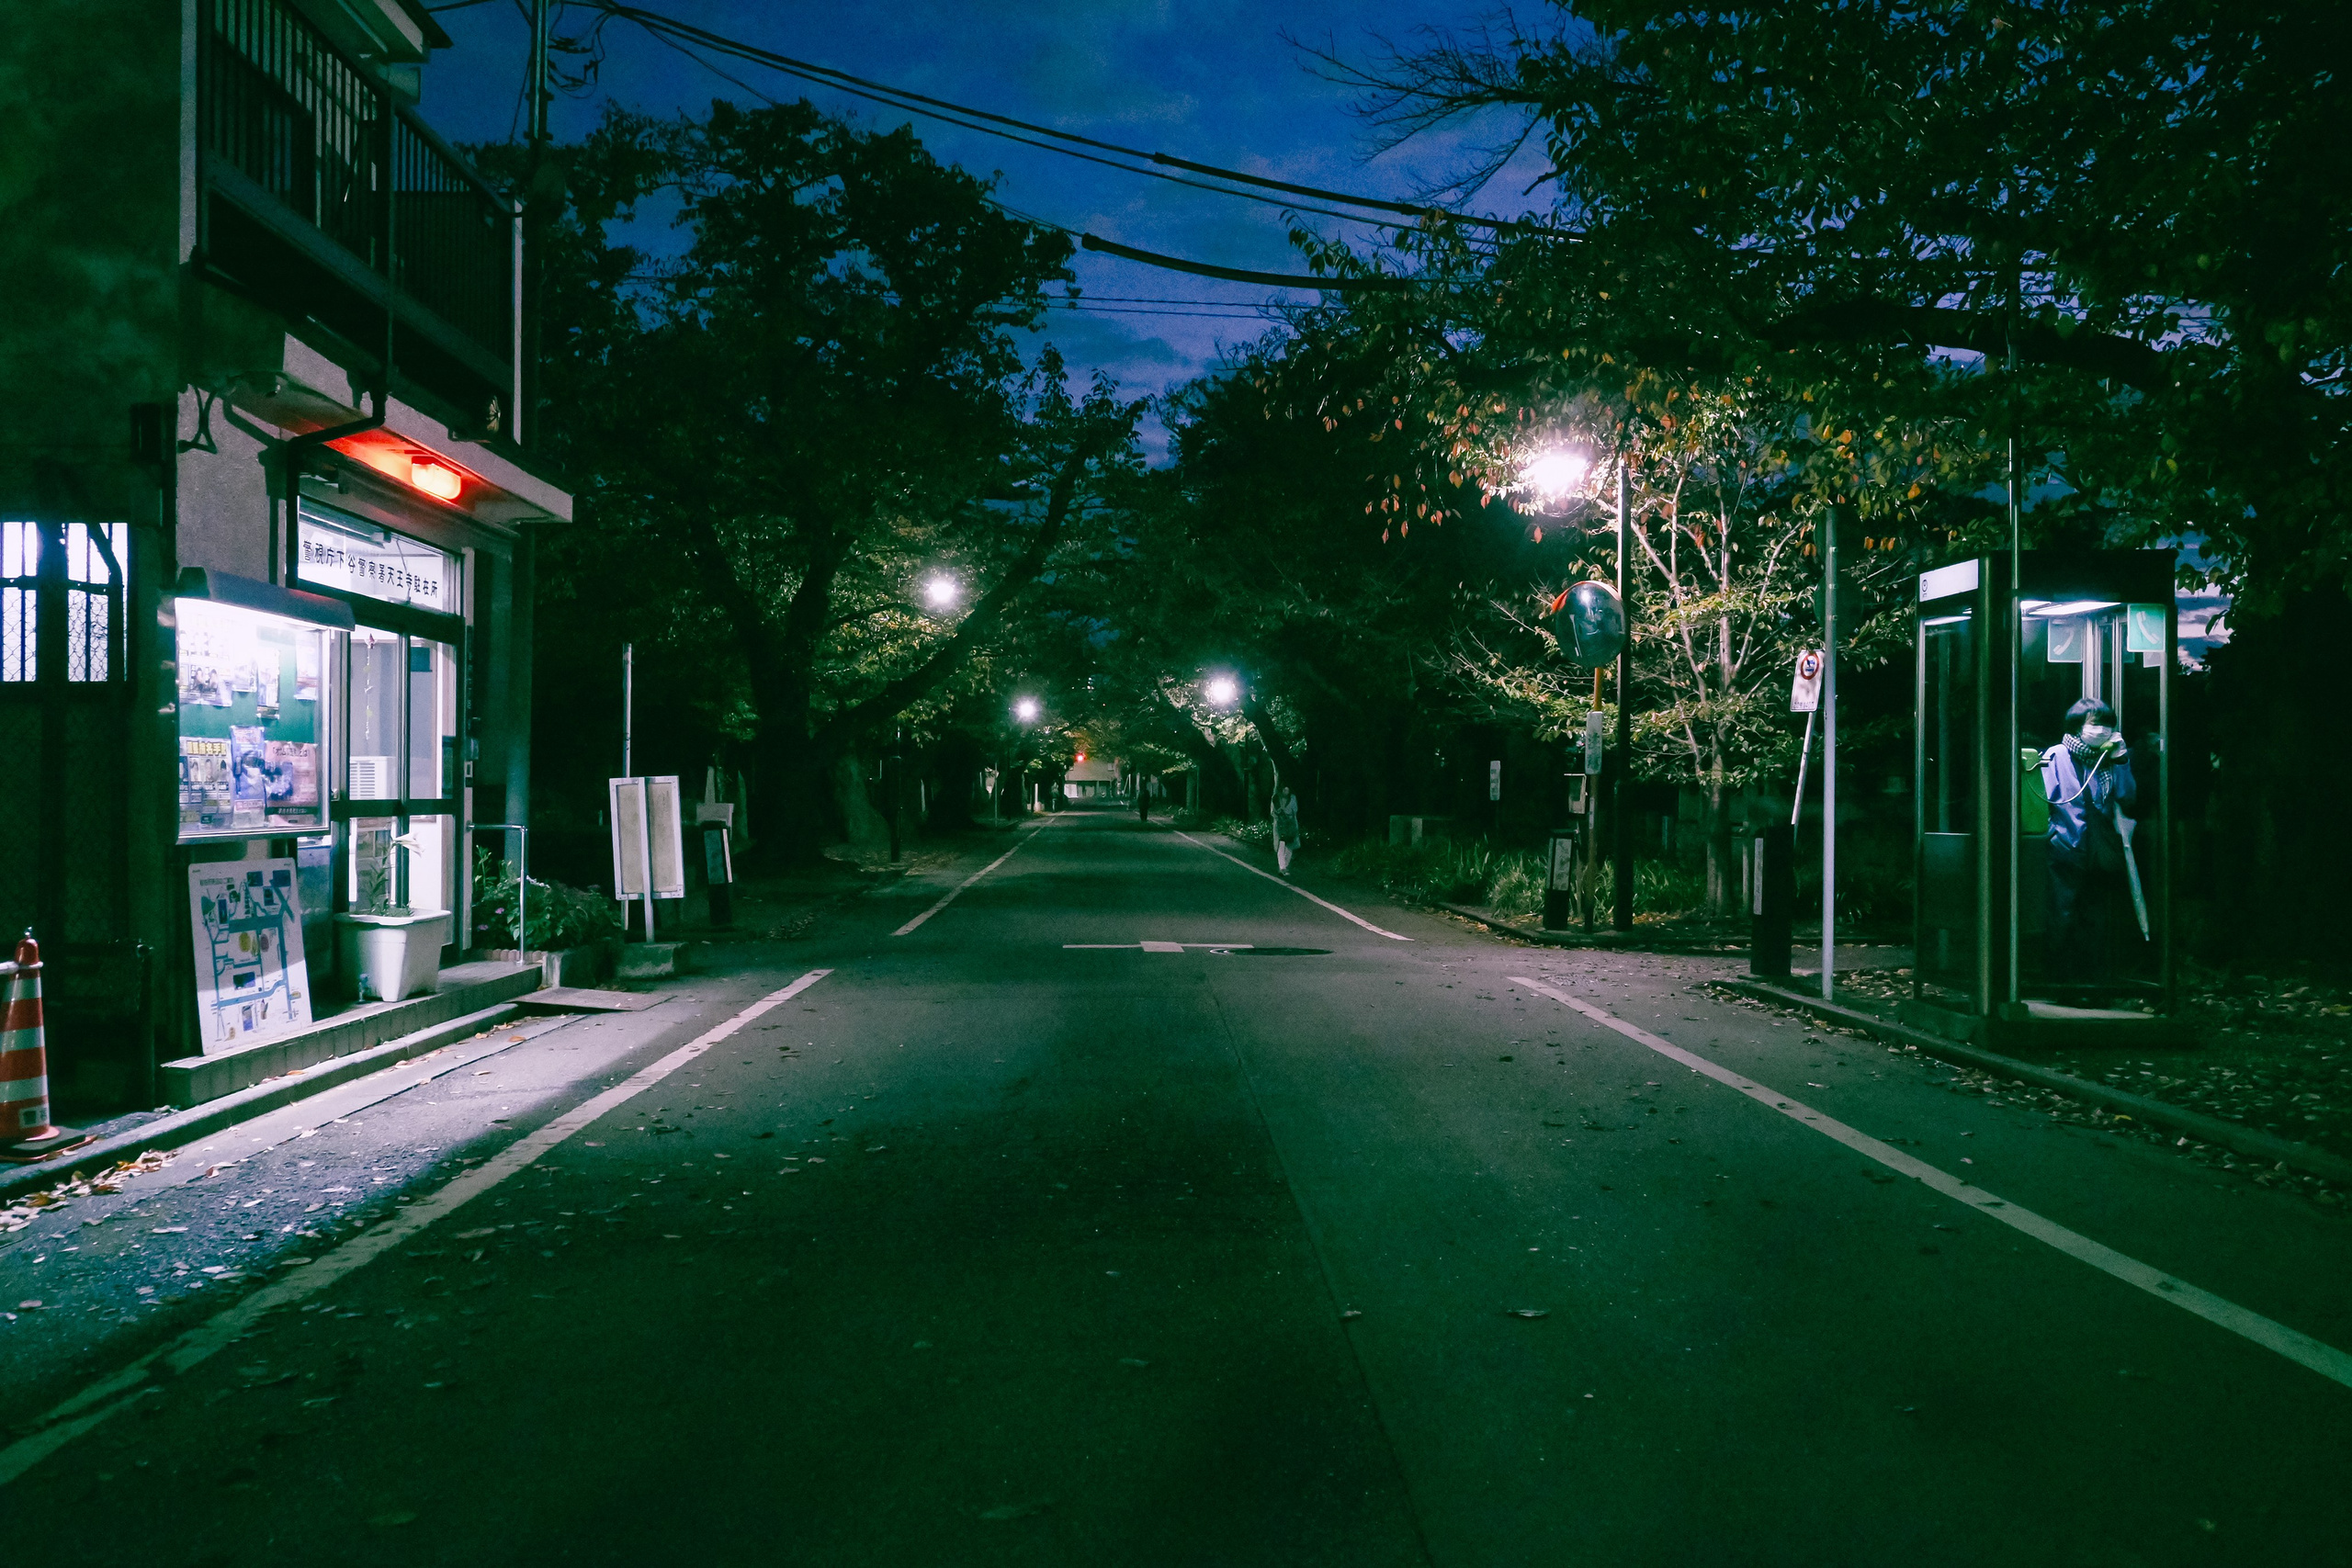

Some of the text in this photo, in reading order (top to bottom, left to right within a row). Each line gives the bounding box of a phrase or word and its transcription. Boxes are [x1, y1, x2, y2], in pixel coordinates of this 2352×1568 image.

[302, 540, 437, 598] 警視庁下谷警察署天王寺駐在所
